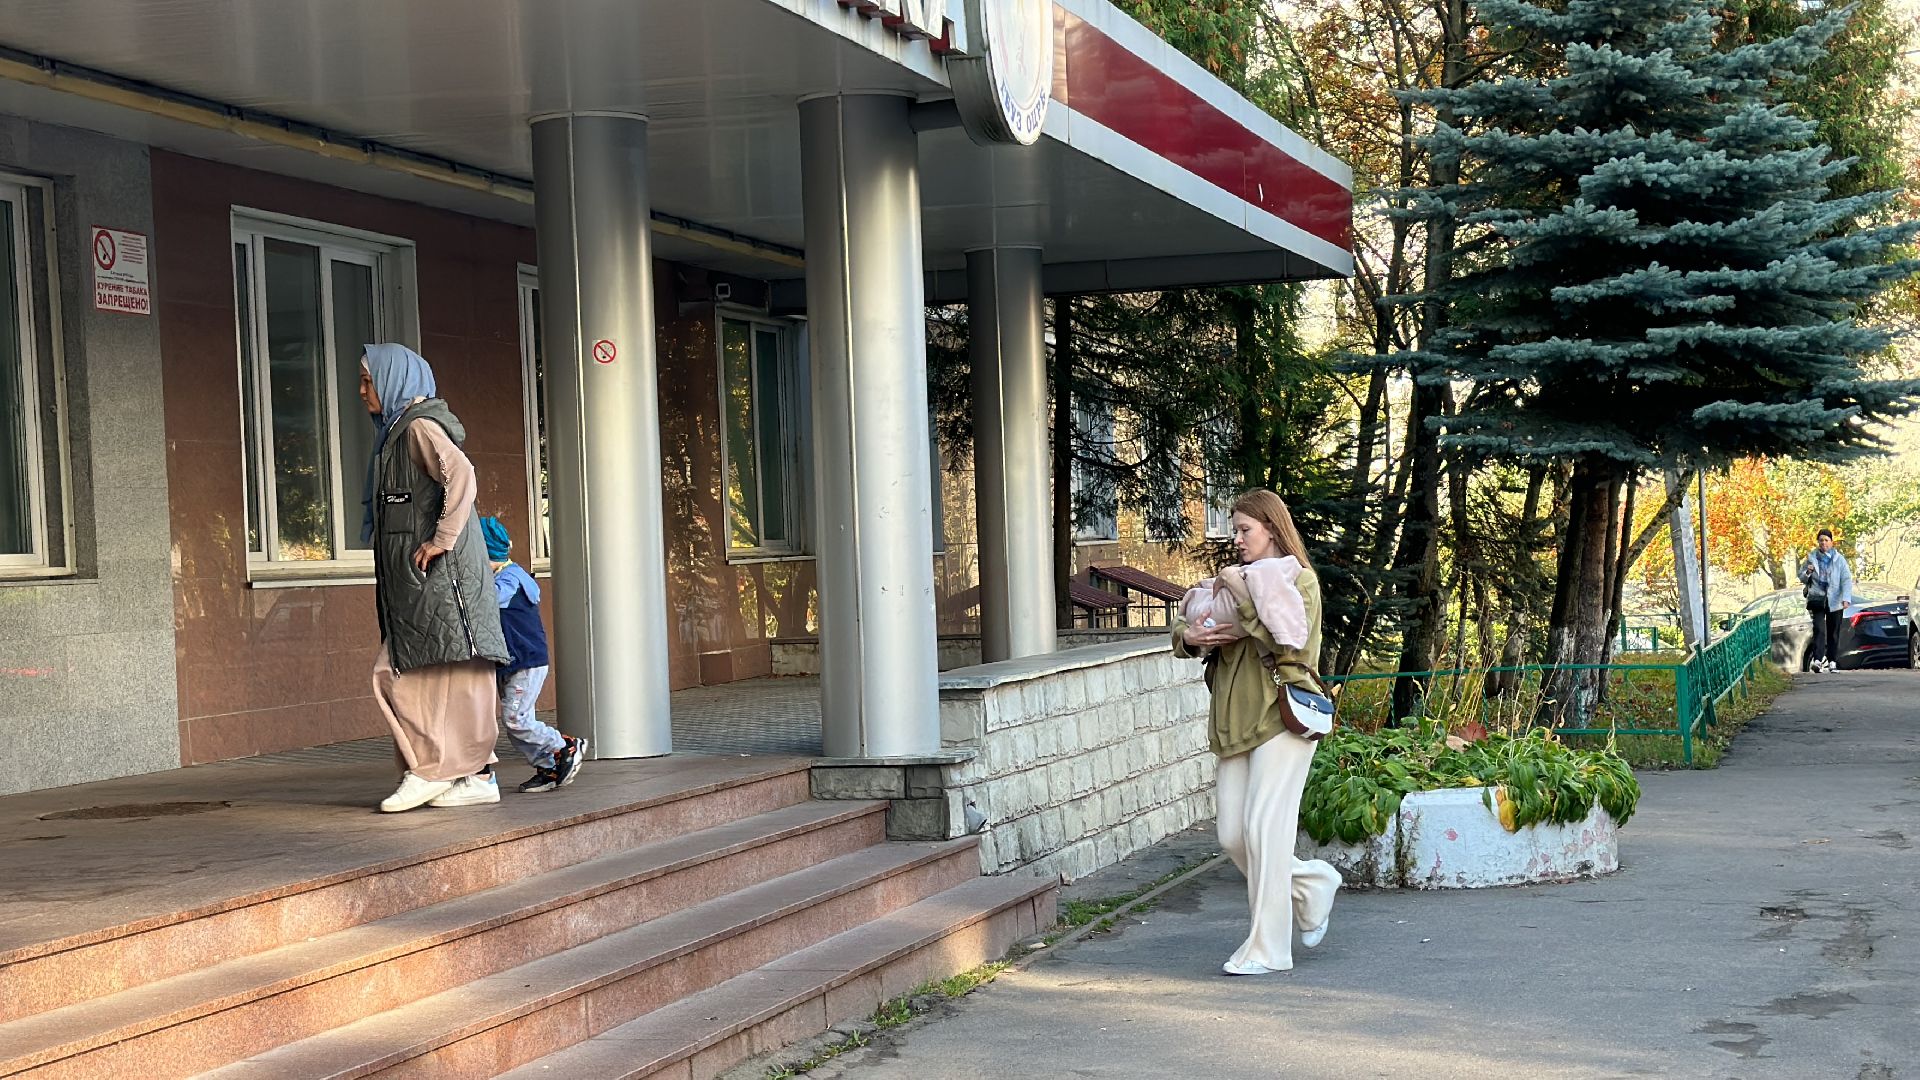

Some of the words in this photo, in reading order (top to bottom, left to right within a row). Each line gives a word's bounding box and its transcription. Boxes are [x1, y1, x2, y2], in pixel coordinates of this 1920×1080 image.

[97, 281, 124, 293] КУРЕНИЕ
[125, 285, 148, 296] ТАБАКА
[97, 292, 149, 311] ЗАПРЕЩЕНО!
